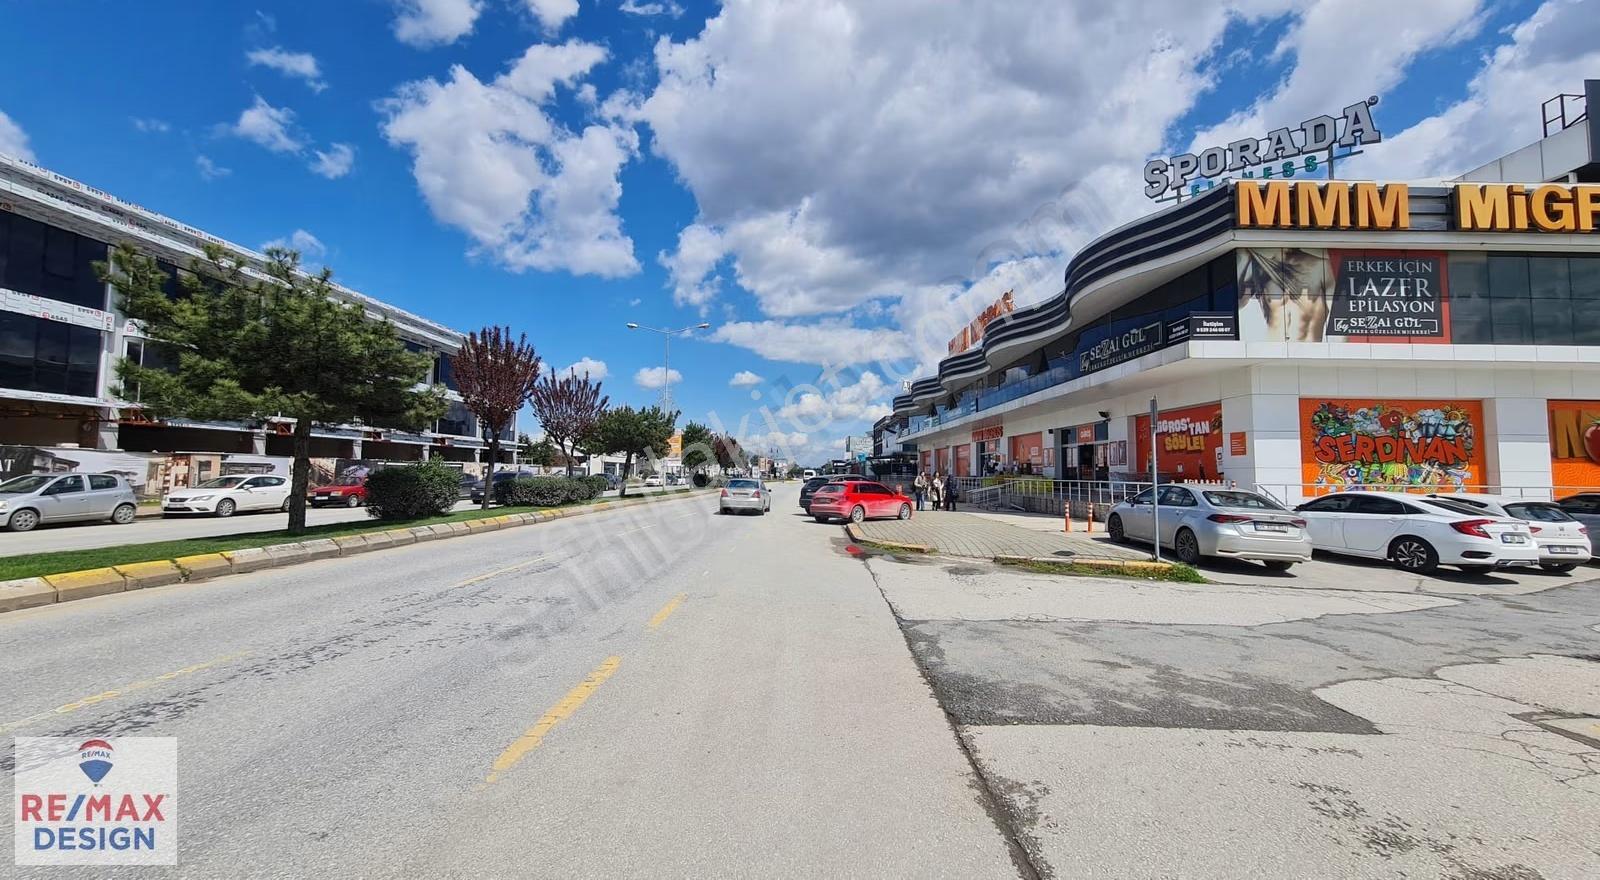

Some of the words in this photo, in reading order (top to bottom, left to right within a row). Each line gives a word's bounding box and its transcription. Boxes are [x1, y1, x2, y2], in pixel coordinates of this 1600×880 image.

[1143, 100, 1381, 199] SPORADA
[1236, 180, 1410, 230] MMM
[1348, 261, 1396, 273] ERKEK
[1399, 259, 1432, 275] İÇİN
[1349, 277, 1432, 297] LAZER
[1349, 298, 1435, 313] EPİLASYON
